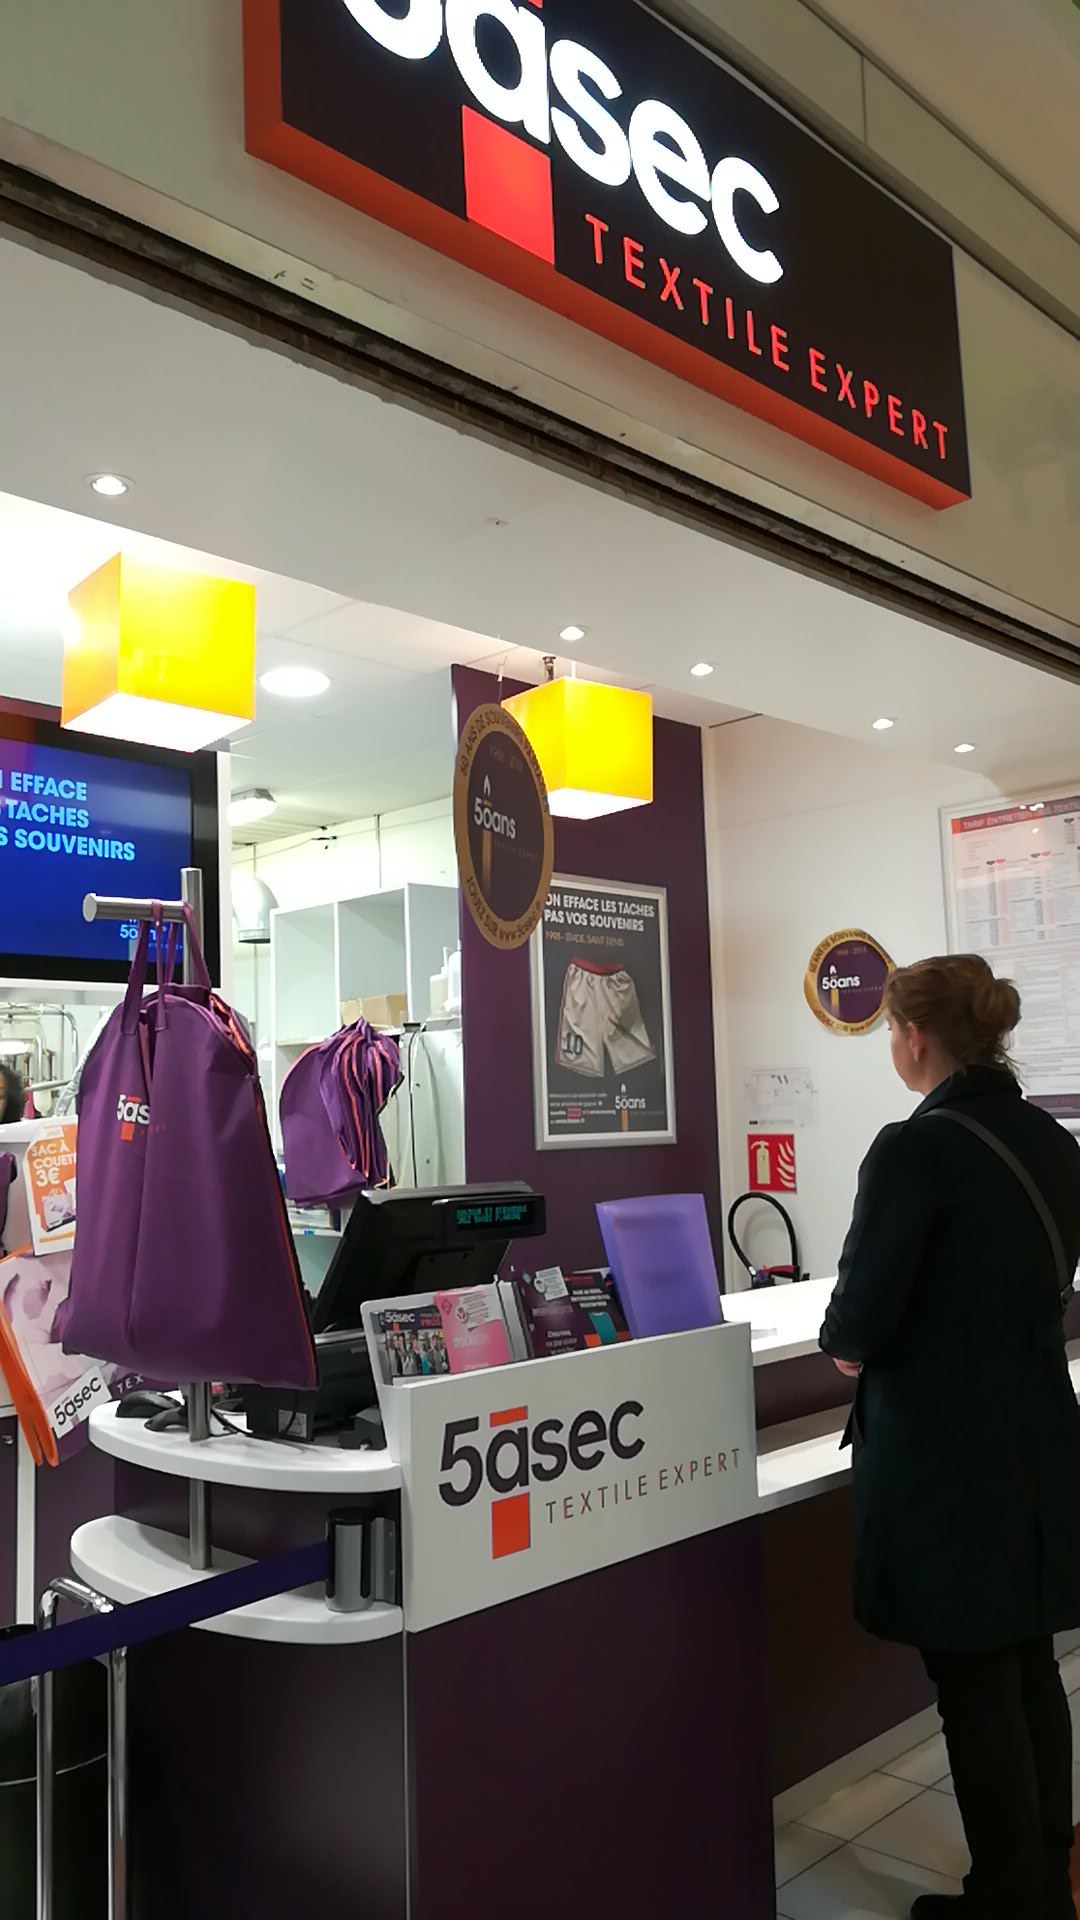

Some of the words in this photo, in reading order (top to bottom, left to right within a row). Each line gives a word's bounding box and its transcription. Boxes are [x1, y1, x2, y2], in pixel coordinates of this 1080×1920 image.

[585, 213, 791, 372] TEXTILE
[809, 348, 950, 460] EXPERT
[10, 772, 88, 801] EFFACE
[6, 799, 90, 829] TACHES
[14, 828, 136, 861] SOUVENIRS
[544, 909, 564, 924] PAS
[565, 911, 587, 926] VOS
[589, 914, 645, 932] SOUVENIRS
[563, 894, 599, 911] EFFACE
[601, 899, 617, 913] LES
[618, 902, 655, 918] TACHES
[31, 1142, 58, 1157] SAC
[35, 1167, 61, 1187] 3€
[54, 1377, 102, 1426] 5asec
[545, 1474, 648, 1524] TEXTILE
[659, 1448, 740, 1491] EXPERT
